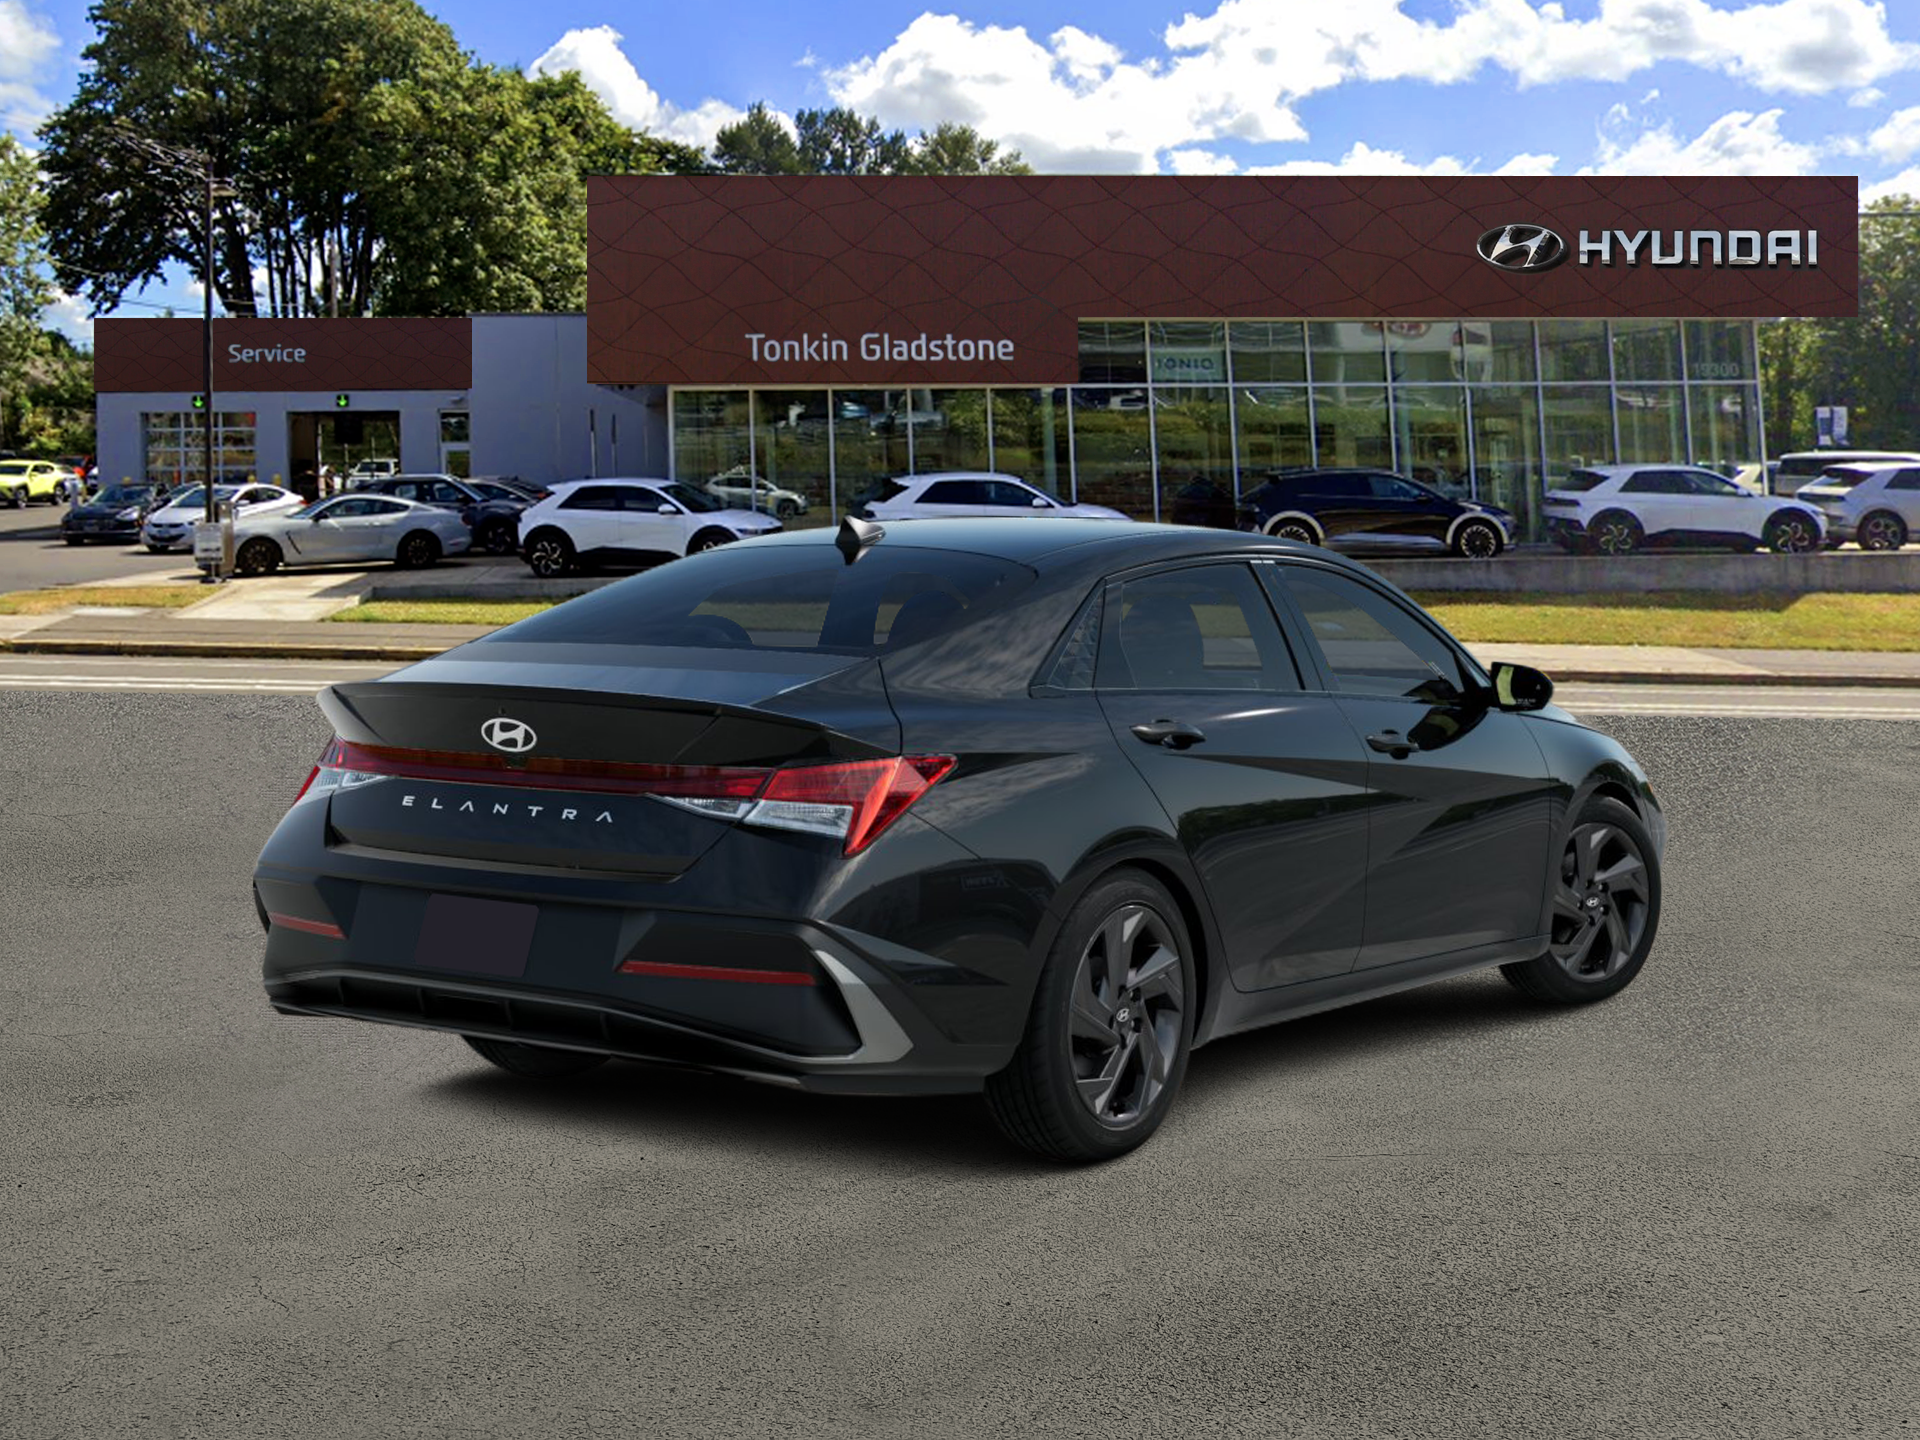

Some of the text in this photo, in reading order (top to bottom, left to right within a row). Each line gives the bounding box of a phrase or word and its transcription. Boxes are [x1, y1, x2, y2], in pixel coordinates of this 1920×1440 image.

[1579, 230, 1817, 265] HYUNDAI
[228, 343, 306, 363] Service
[745, 333, 1015, 362] Tonkin Gladstone
[402, 795, 613, 823] ELANTRA
